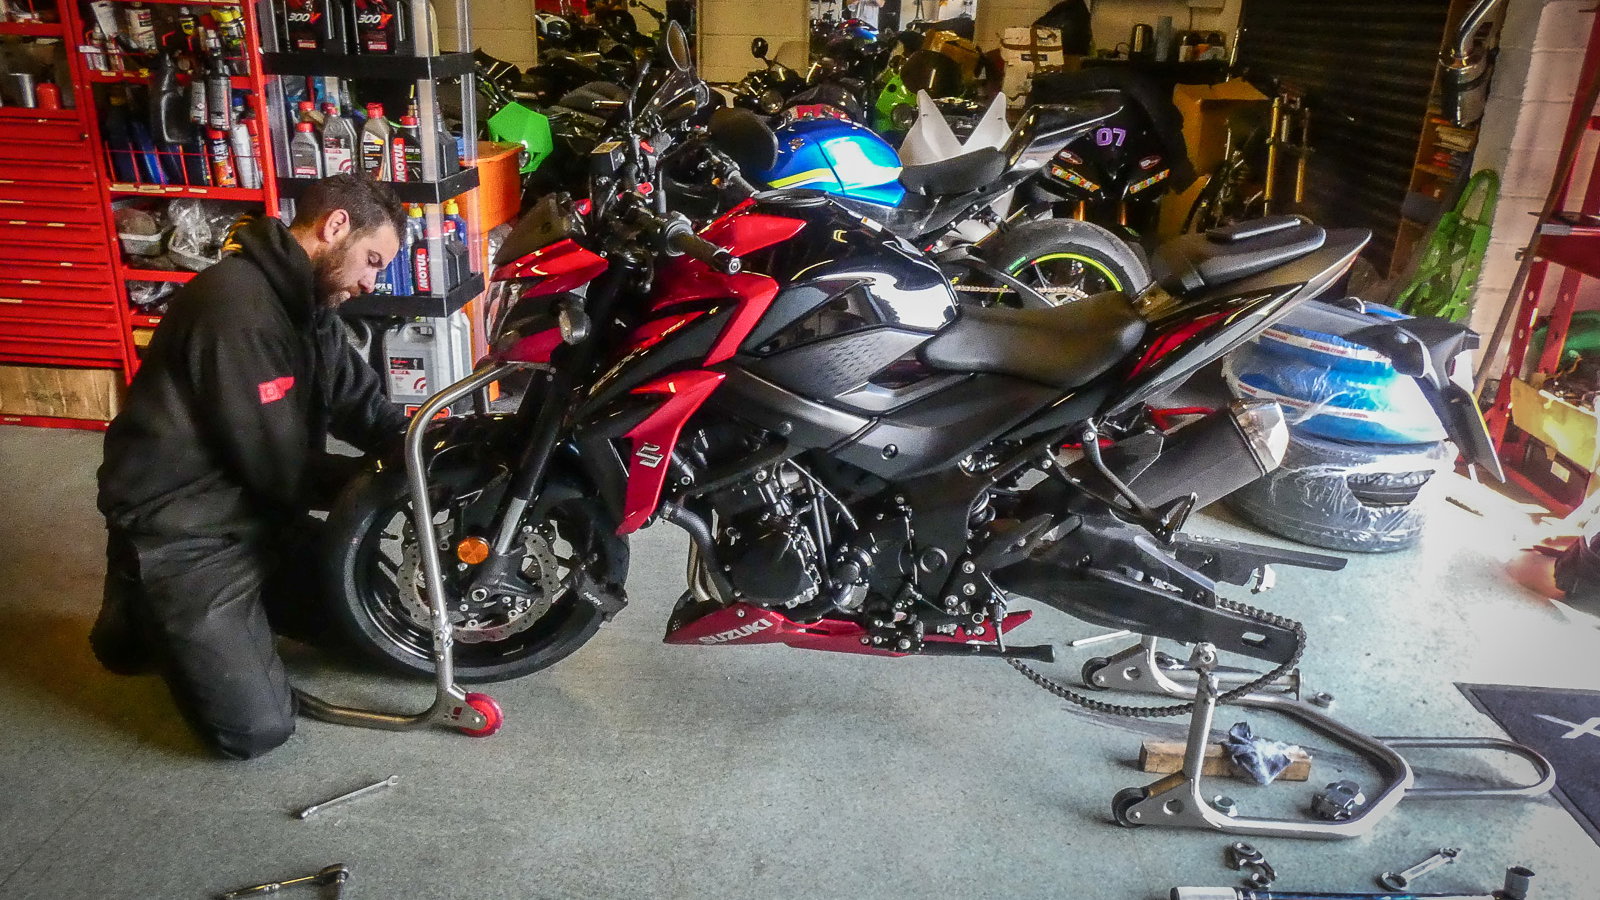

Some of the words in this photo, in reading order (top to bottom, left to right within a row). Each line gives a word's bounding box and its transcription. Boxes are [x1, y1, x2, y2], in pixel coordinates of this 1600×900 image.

[288, 12, 321, 24] 300V
[357, 12, 393, 26] 300V
[1096, 127, 1126, 147] 07
[393, 143, 406, 182] MOTUL
[417, 254, 429, 289] MOTUL
[698, 618, 774, 645] SUZUKI
